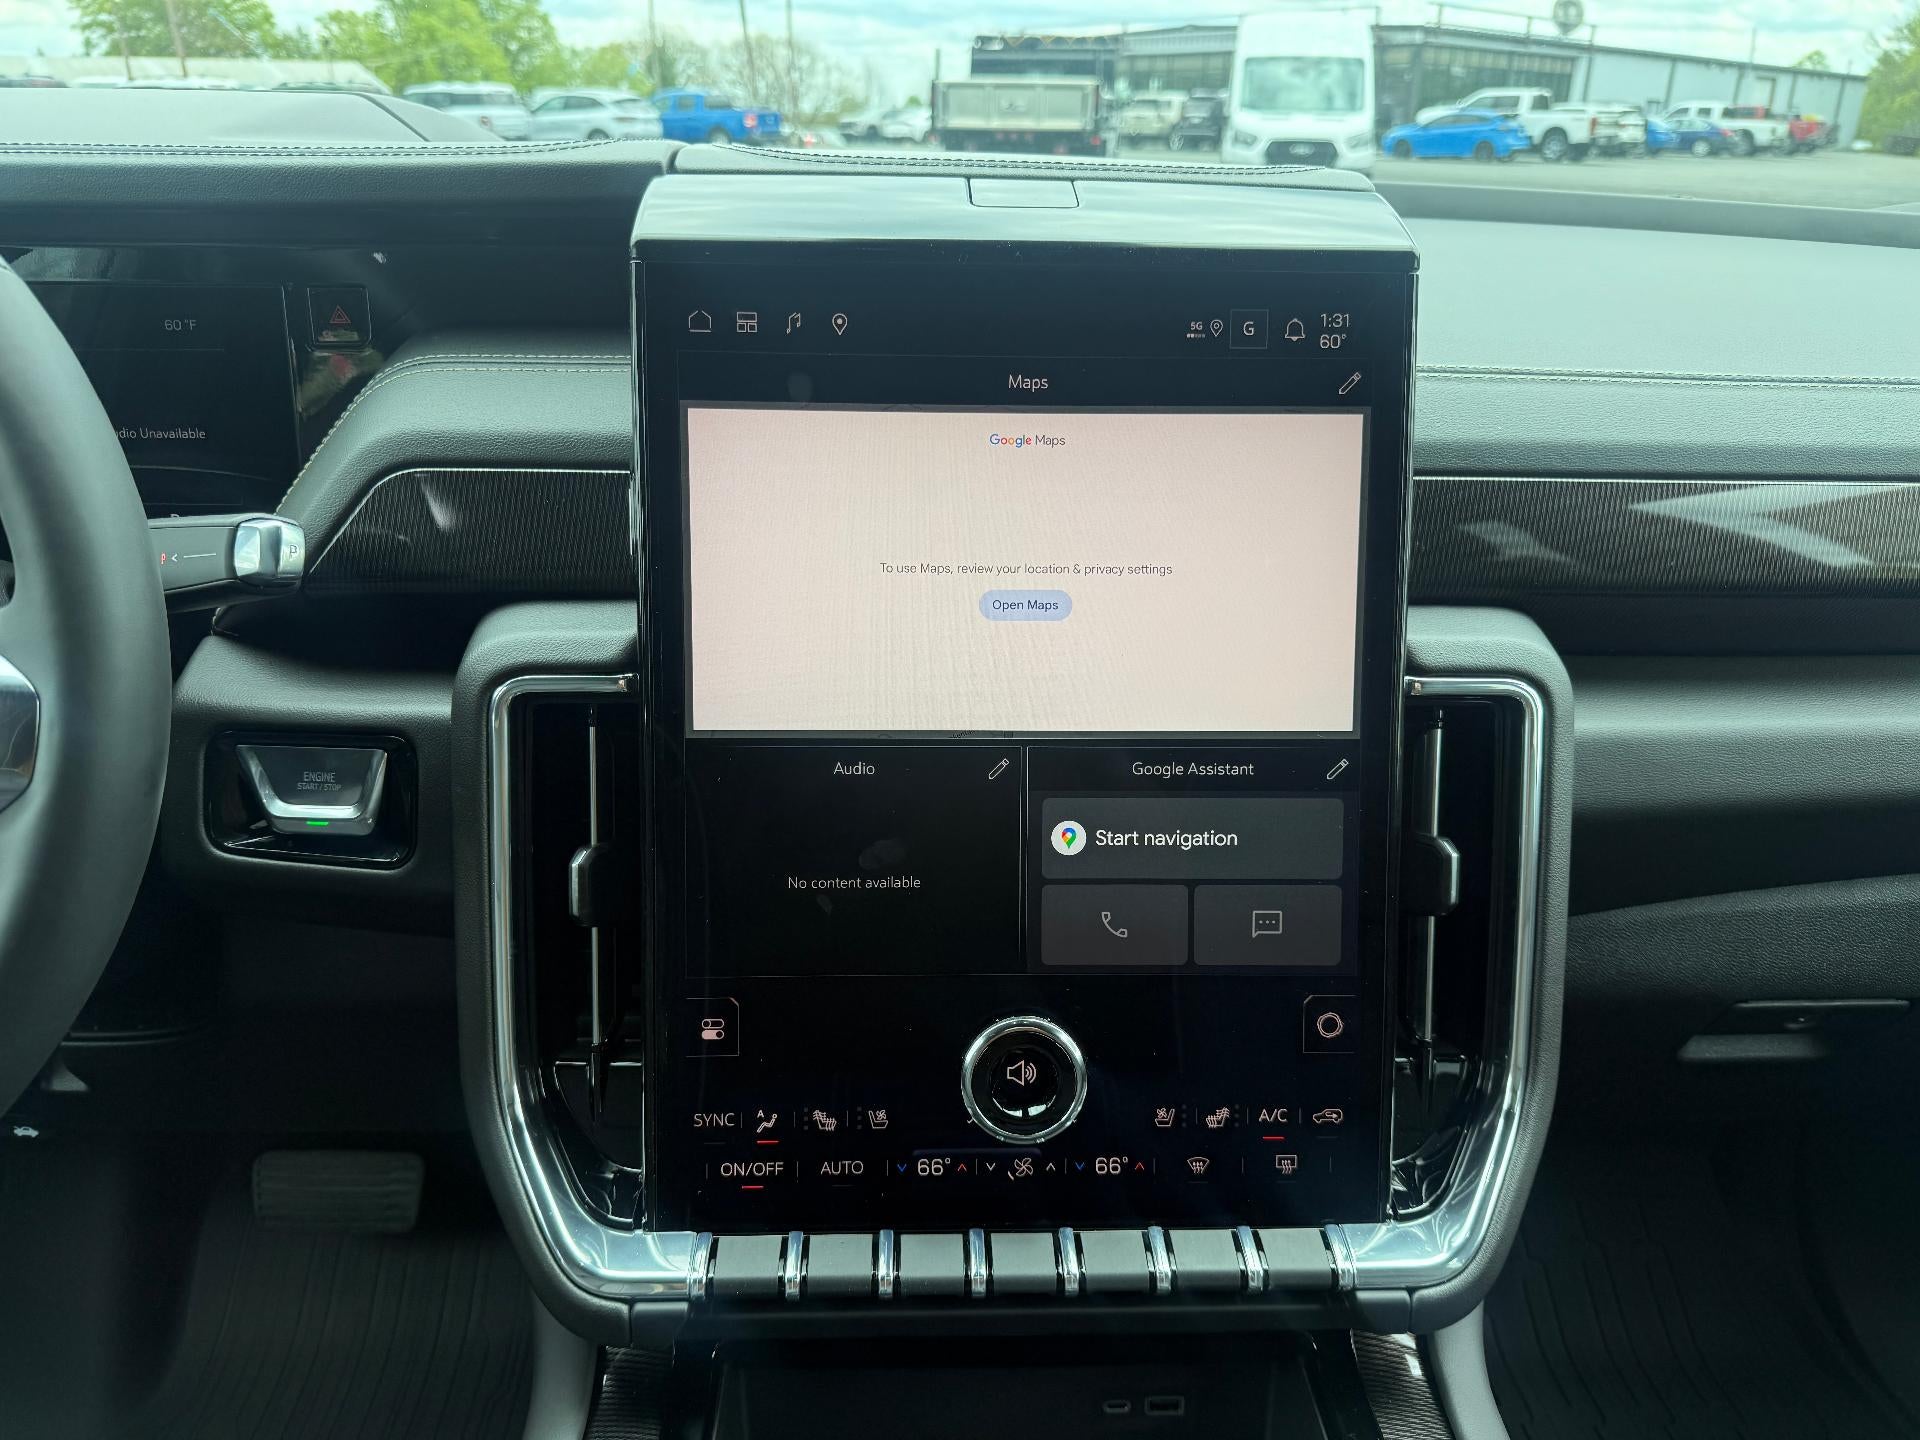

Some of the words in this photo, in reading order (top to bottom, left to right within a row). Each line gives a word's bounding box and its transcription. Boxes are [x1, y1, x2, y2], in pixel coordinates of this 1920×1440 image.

[1190, 321, 1203, 331] 5G
[1320, 313, 1351, 328] 1:31
[1243, 321, 1255, 336] G
[1319, 333, 1347, 349] 60°
[1008, 374, 1049, 392] Maps
[139, 427, 206, 439] Unavailable
[989, 433, 1032, 448] Google
[1035, 434, 1066, 448] Maps
[880, 562, 893, 574] To
[896, 564, 916, 574] use
[920, 563, 953, 577] Maps,
[957, 564, 992, 574] review
[995, 564, 1021, 578] your
[1024, 563, 1069, 575] location
[1072, 563, 1081, 575] &
[1083, 563, 1124, 578] privacy
[1127, 563, 1173, 578] settings
[992, 599, 1024, 613] Open
[1027, 599, 1059, 613] Maps
[833, 762, 875, 775] Audio
[1132, 762, 1184, 779] Google
[1188, 762, 1254, 775] Assistant
[303, 771, 336, 782] ENGINE
[1095, 829, 1139, 846] Start
[1144, 829, 1238, 850] navigation
[788, 876, 807, 889] No
[811, 877, 862, 889] content
[865, 875, 921, 888] available
[693, 1113, 735, 1127] SYNC
[1258, 1108, 1288, 1123] A/C
[720, 1161, 785, 1178] ON/OFF
[820, 1160, 864, 1176] AUTO
[916, 1157, 951, 1177] 66°
[1095, 1156, 1129, 1175] 66°
